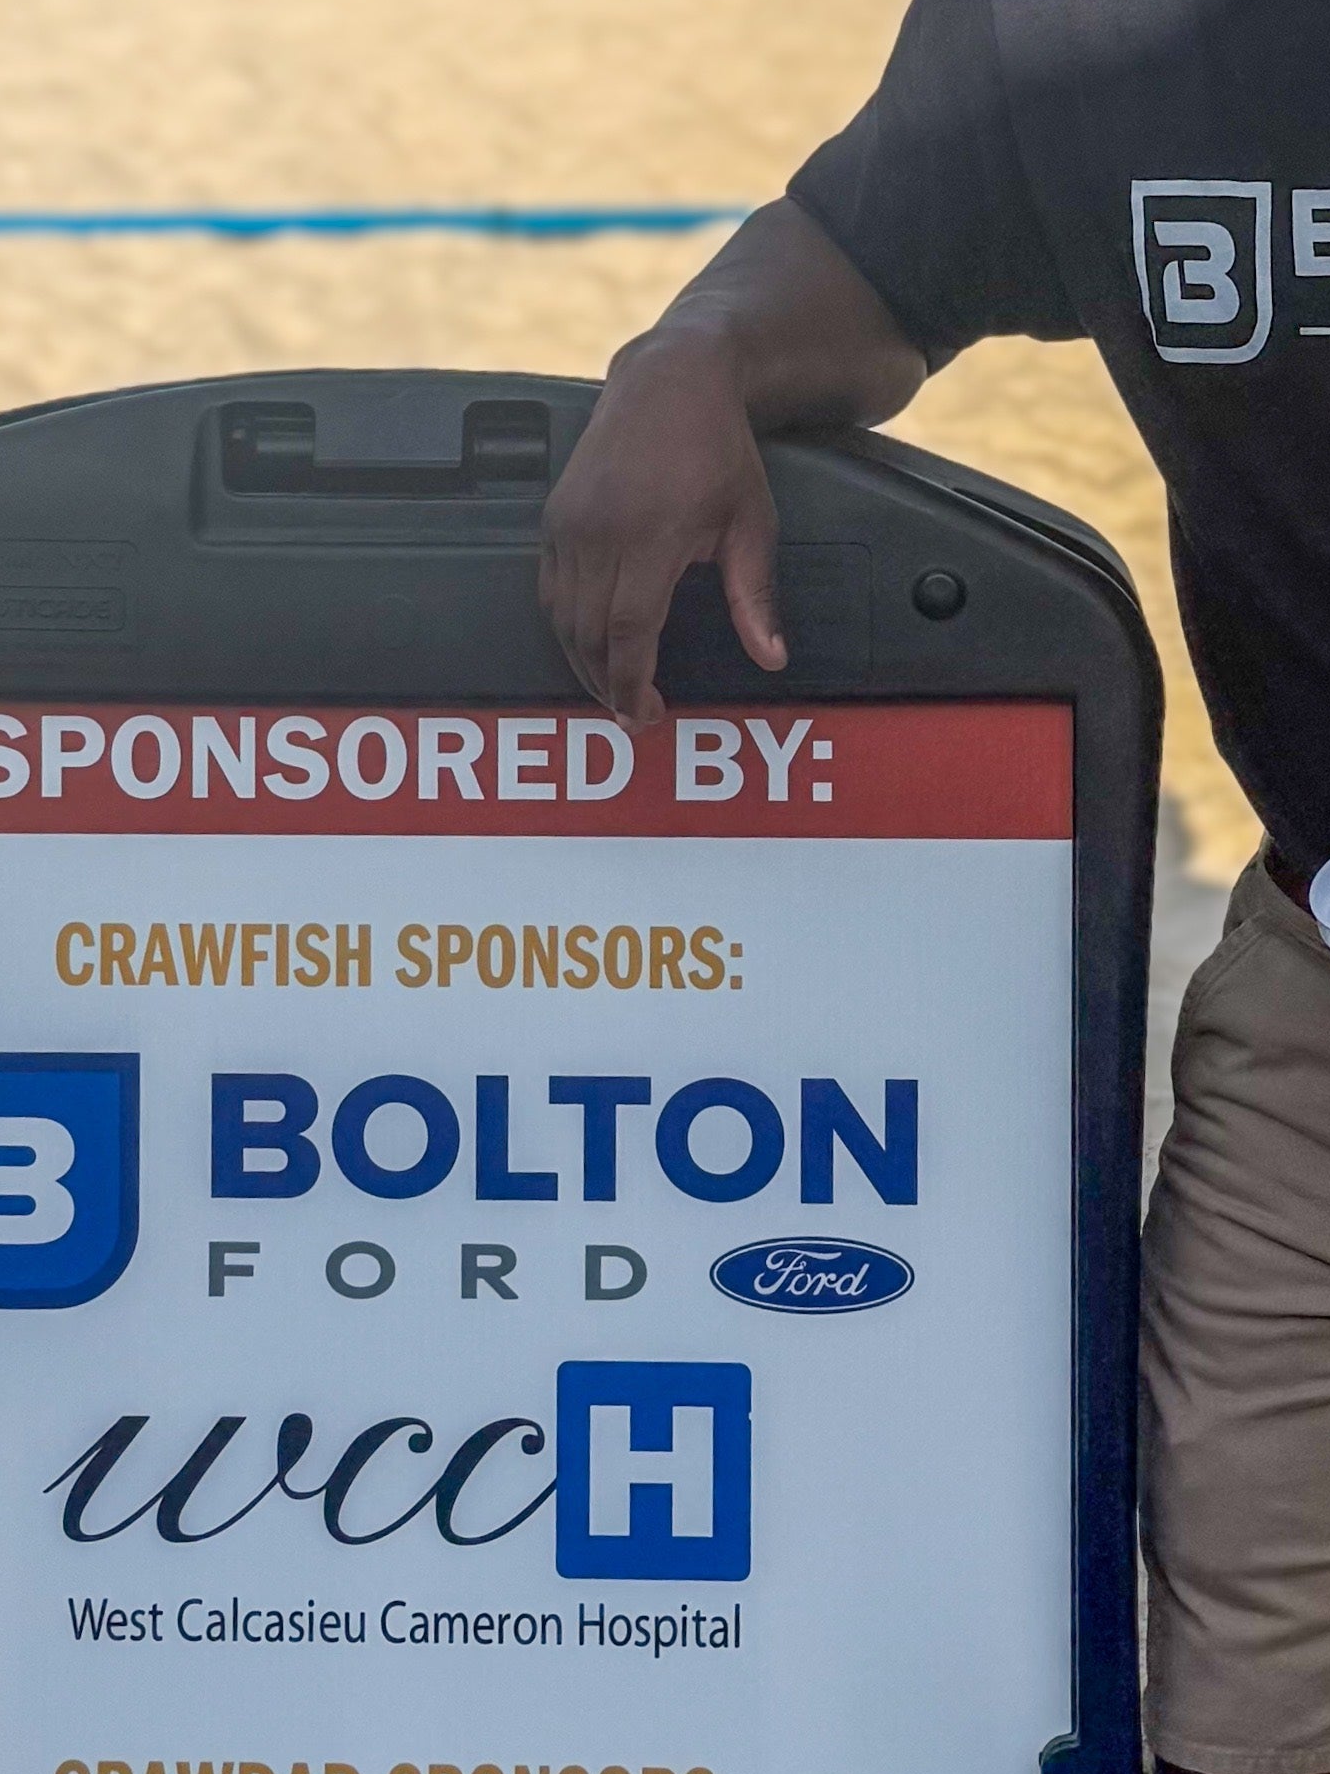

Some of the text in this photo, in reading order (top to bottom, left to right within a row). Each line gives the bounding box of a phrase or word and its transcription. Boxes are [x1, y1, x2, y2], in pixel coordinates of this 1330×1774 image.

[676, 719, 834, 803] BY:
[56, 922, 744, 992] CRAWFISH SPONSORS:
[211, 1073, 920, 1207] BOLTON
[209, 1241, 649, 1302] FORD
[751, 1246, 872, 1301] Ford
[69, 1597, 742, 1660] West Calcasieu Cameron Hospital
